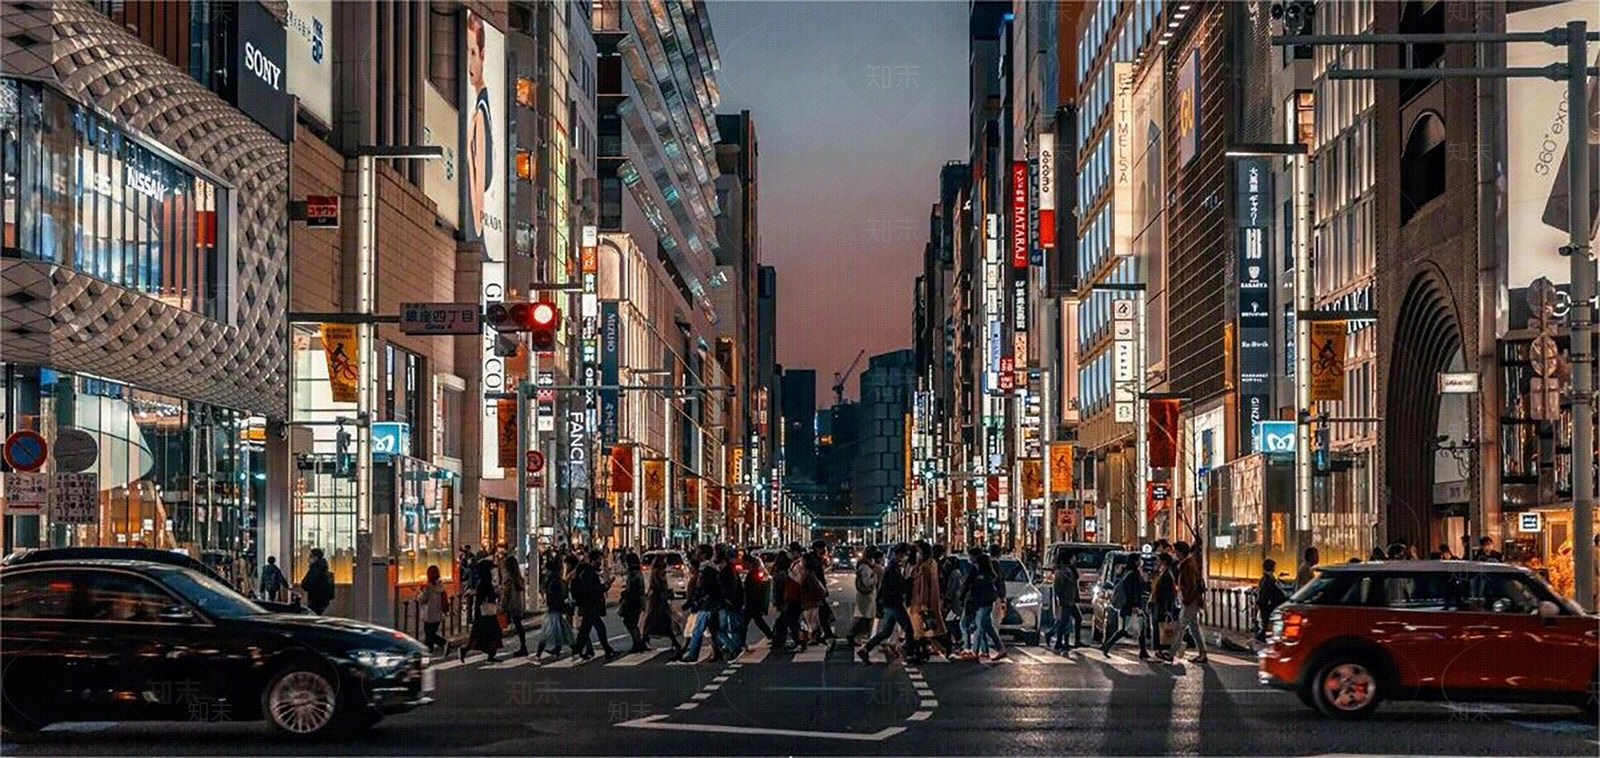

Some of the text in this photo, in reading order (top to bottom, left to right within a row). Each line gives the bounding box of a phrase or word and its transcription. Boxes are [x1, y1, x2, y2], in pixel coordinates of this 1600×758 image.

[245, 42, 281, 90] SONY
[1118, 73, 1128, 183] EXITMELSA
[126, 165, 168, 202] NISSAN
[1042, 150, 1052, 193] docomo
[1015, 206, 1025, 260] NATARAJ
